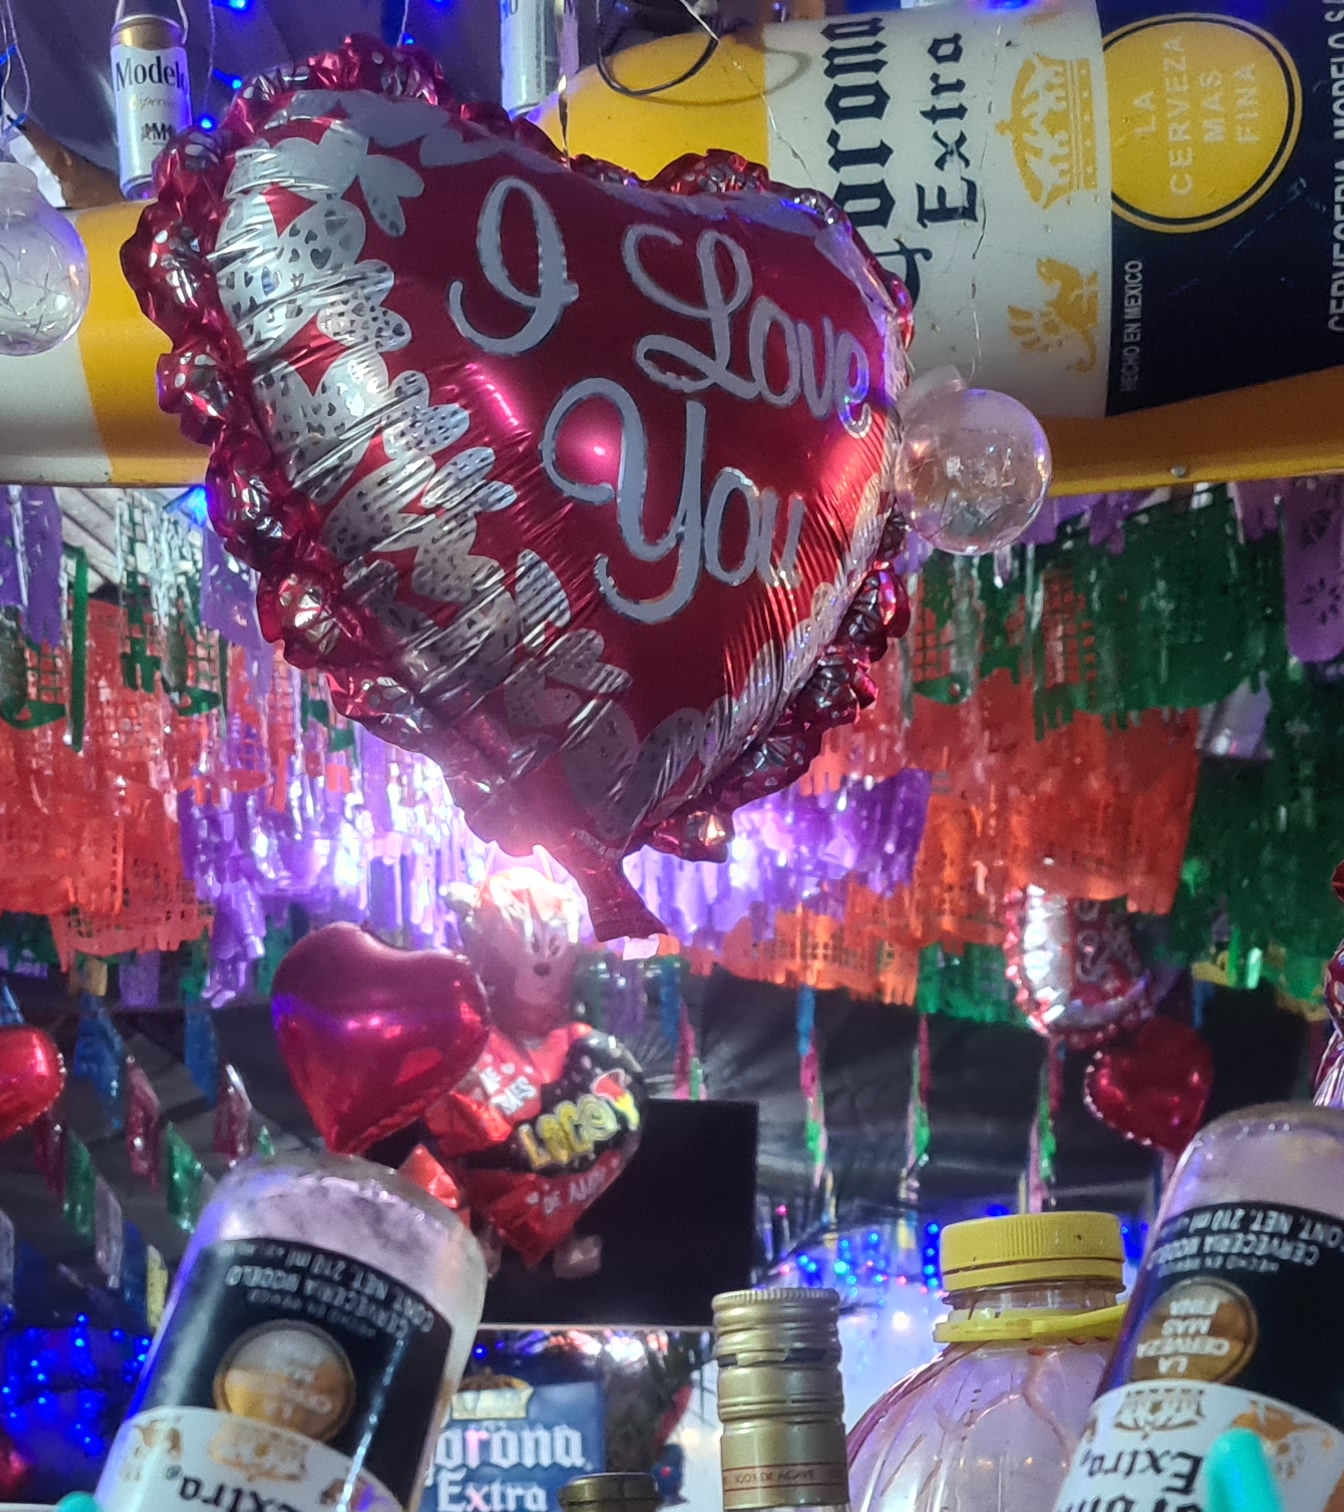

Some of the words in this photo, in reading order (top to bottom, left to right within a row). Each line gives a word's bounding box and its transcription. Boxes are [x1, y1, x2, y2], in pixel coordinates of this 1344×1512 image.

[915, 32, 979, 230] Extra
[1134, 90, 1157, 138] LA
[1162, 36, 1195, 197] CERVEZA
[1198, 70, 1229, 145] MAS
[1233, 62, 1261, 145] FINA
[448, 176, 580, 355] I
[620, 221, 872, 440] Love
[1123, 259, 1144, 323] MEXICO
[1122, 324, 1143, 343] EN
[539, 376, 809, 625] You
[1202, 1231, 1320, 1267] CERVECERIA
[1249, 1208, 1294, 1235] NET.
[1087, 1449, 1204, 1495] Extra
